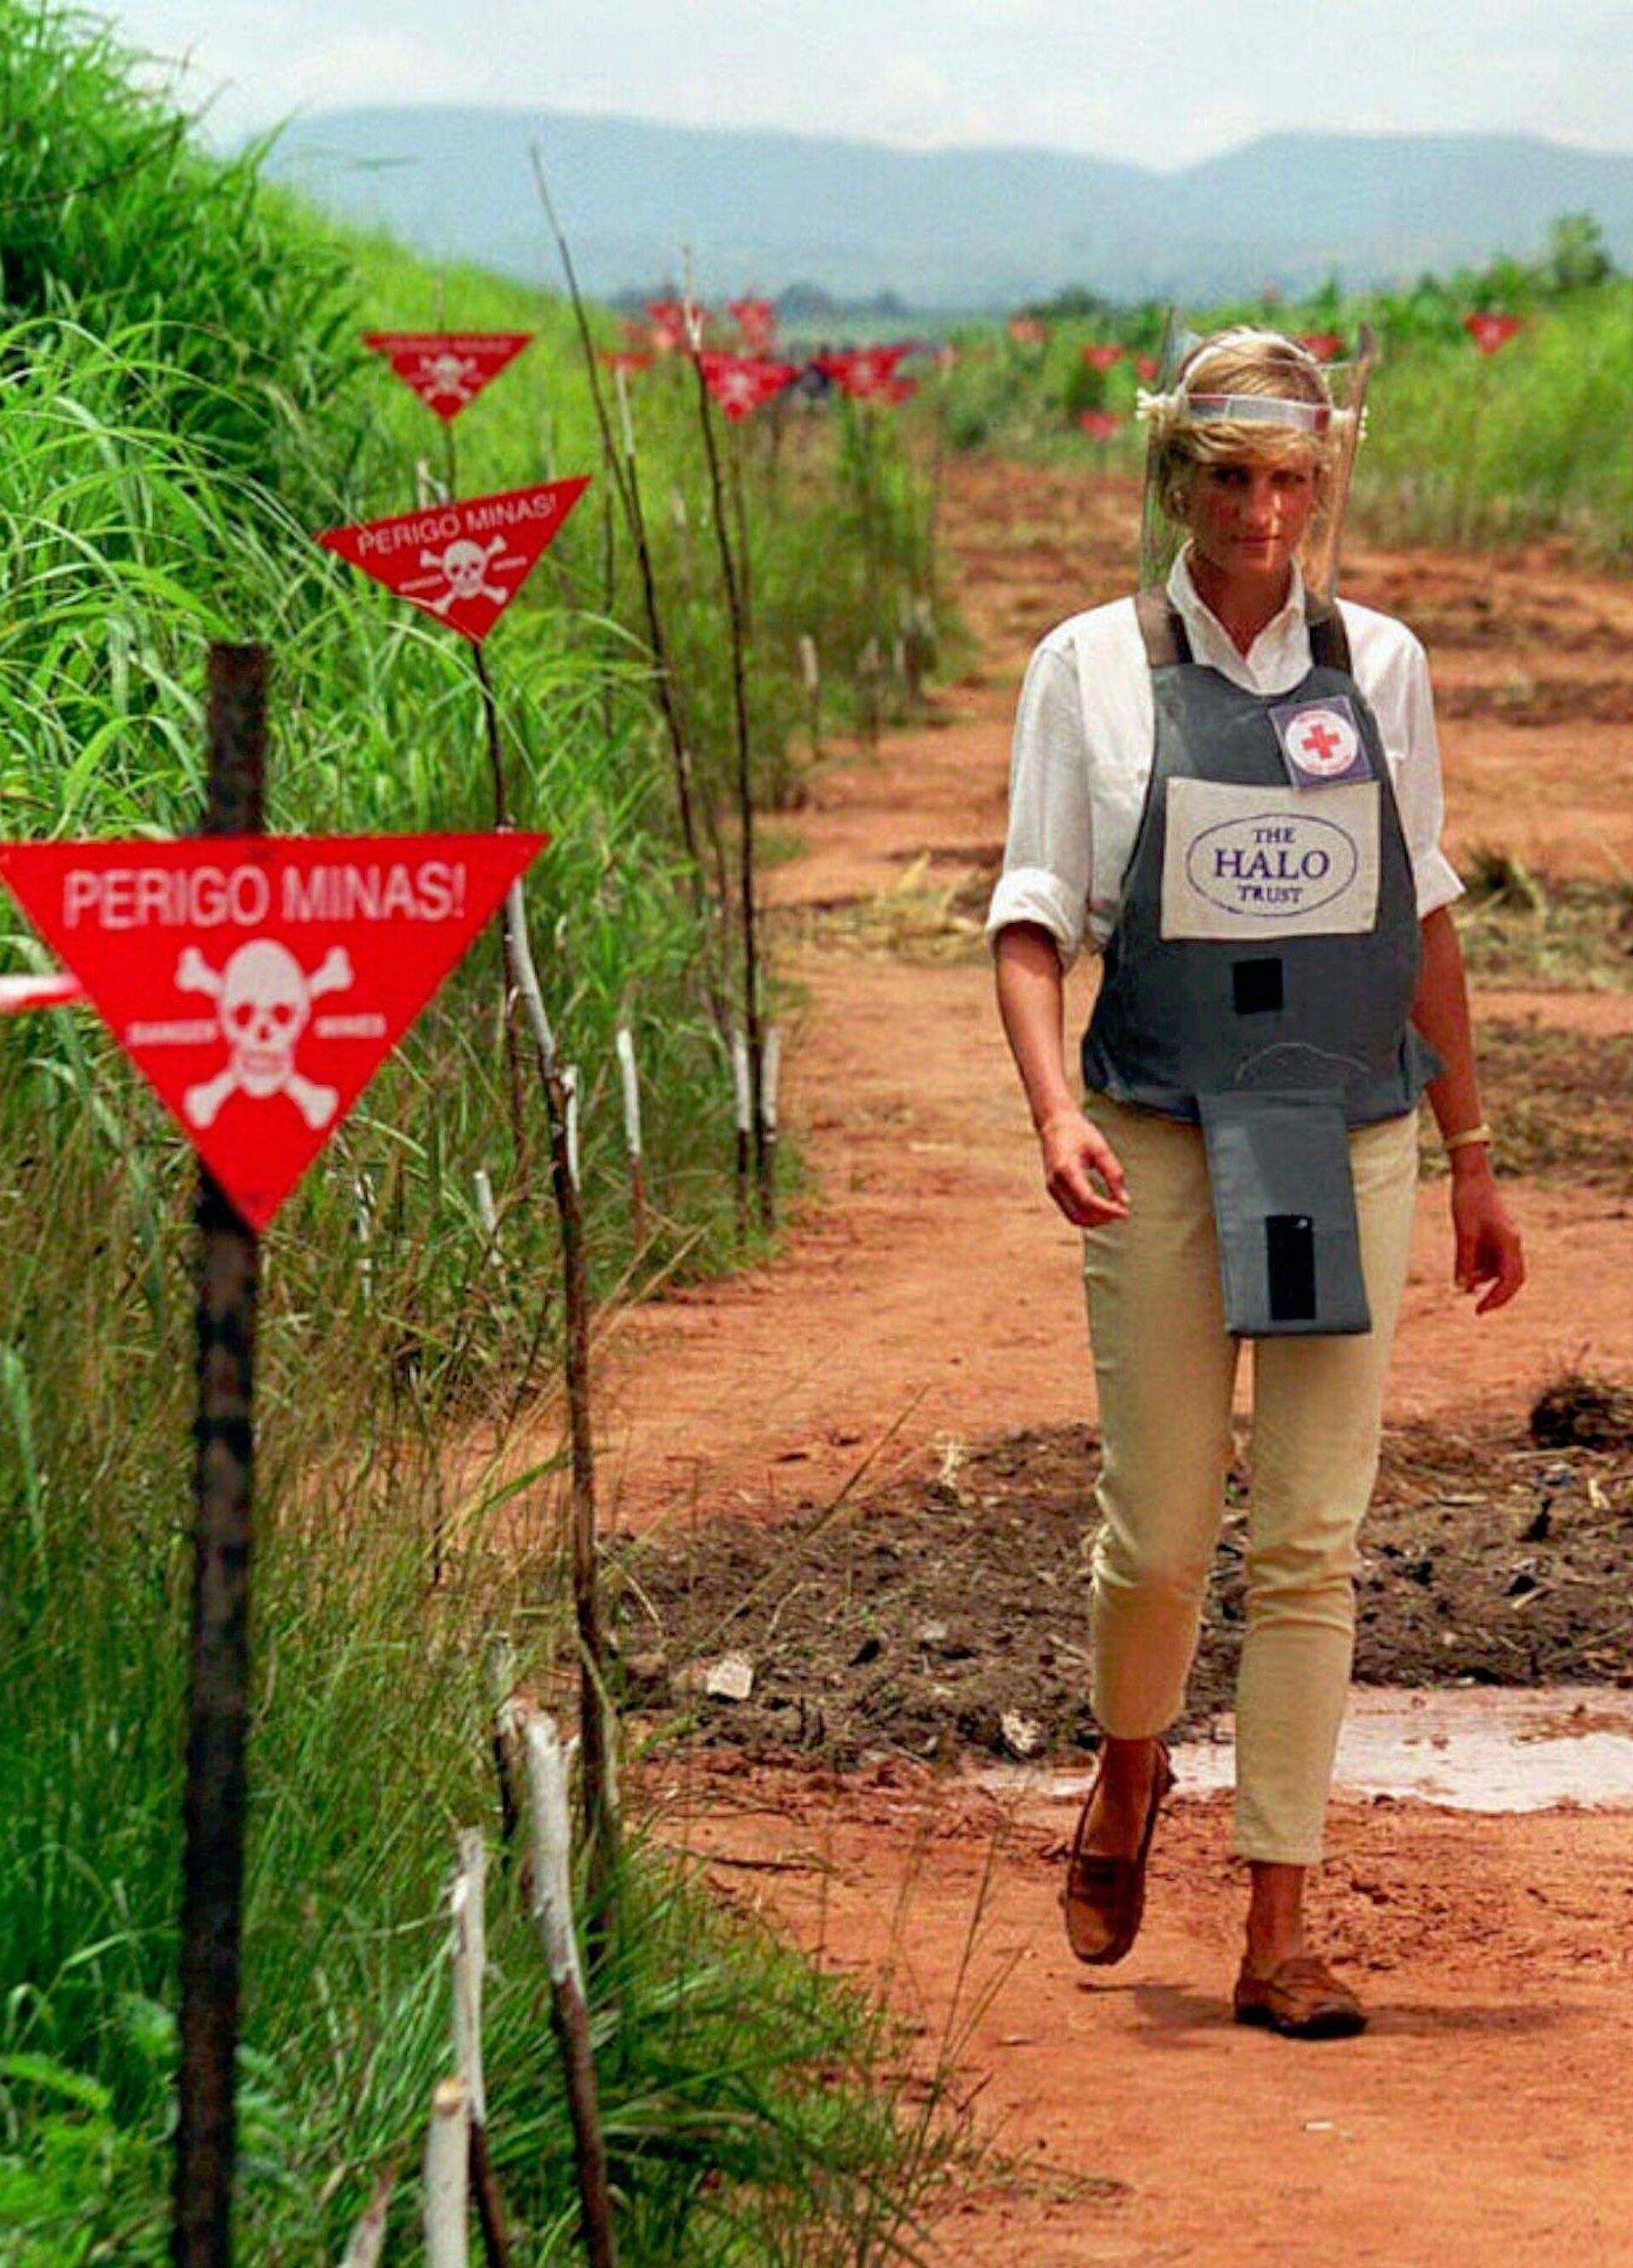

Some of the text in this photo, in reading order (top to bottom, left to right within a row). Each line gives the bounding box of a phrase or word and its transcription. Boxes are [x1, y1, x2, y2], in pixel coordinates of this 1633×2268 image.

[358, 493, 556, 555] PERIGO MINAS!
[1254, 828, 1295, 844] THE
[1215, 850, 1329, 879] HALO
[63, 862, 466, 929] PERIGO MINAS!
[1238, 886, 1302, 903] TRUST
